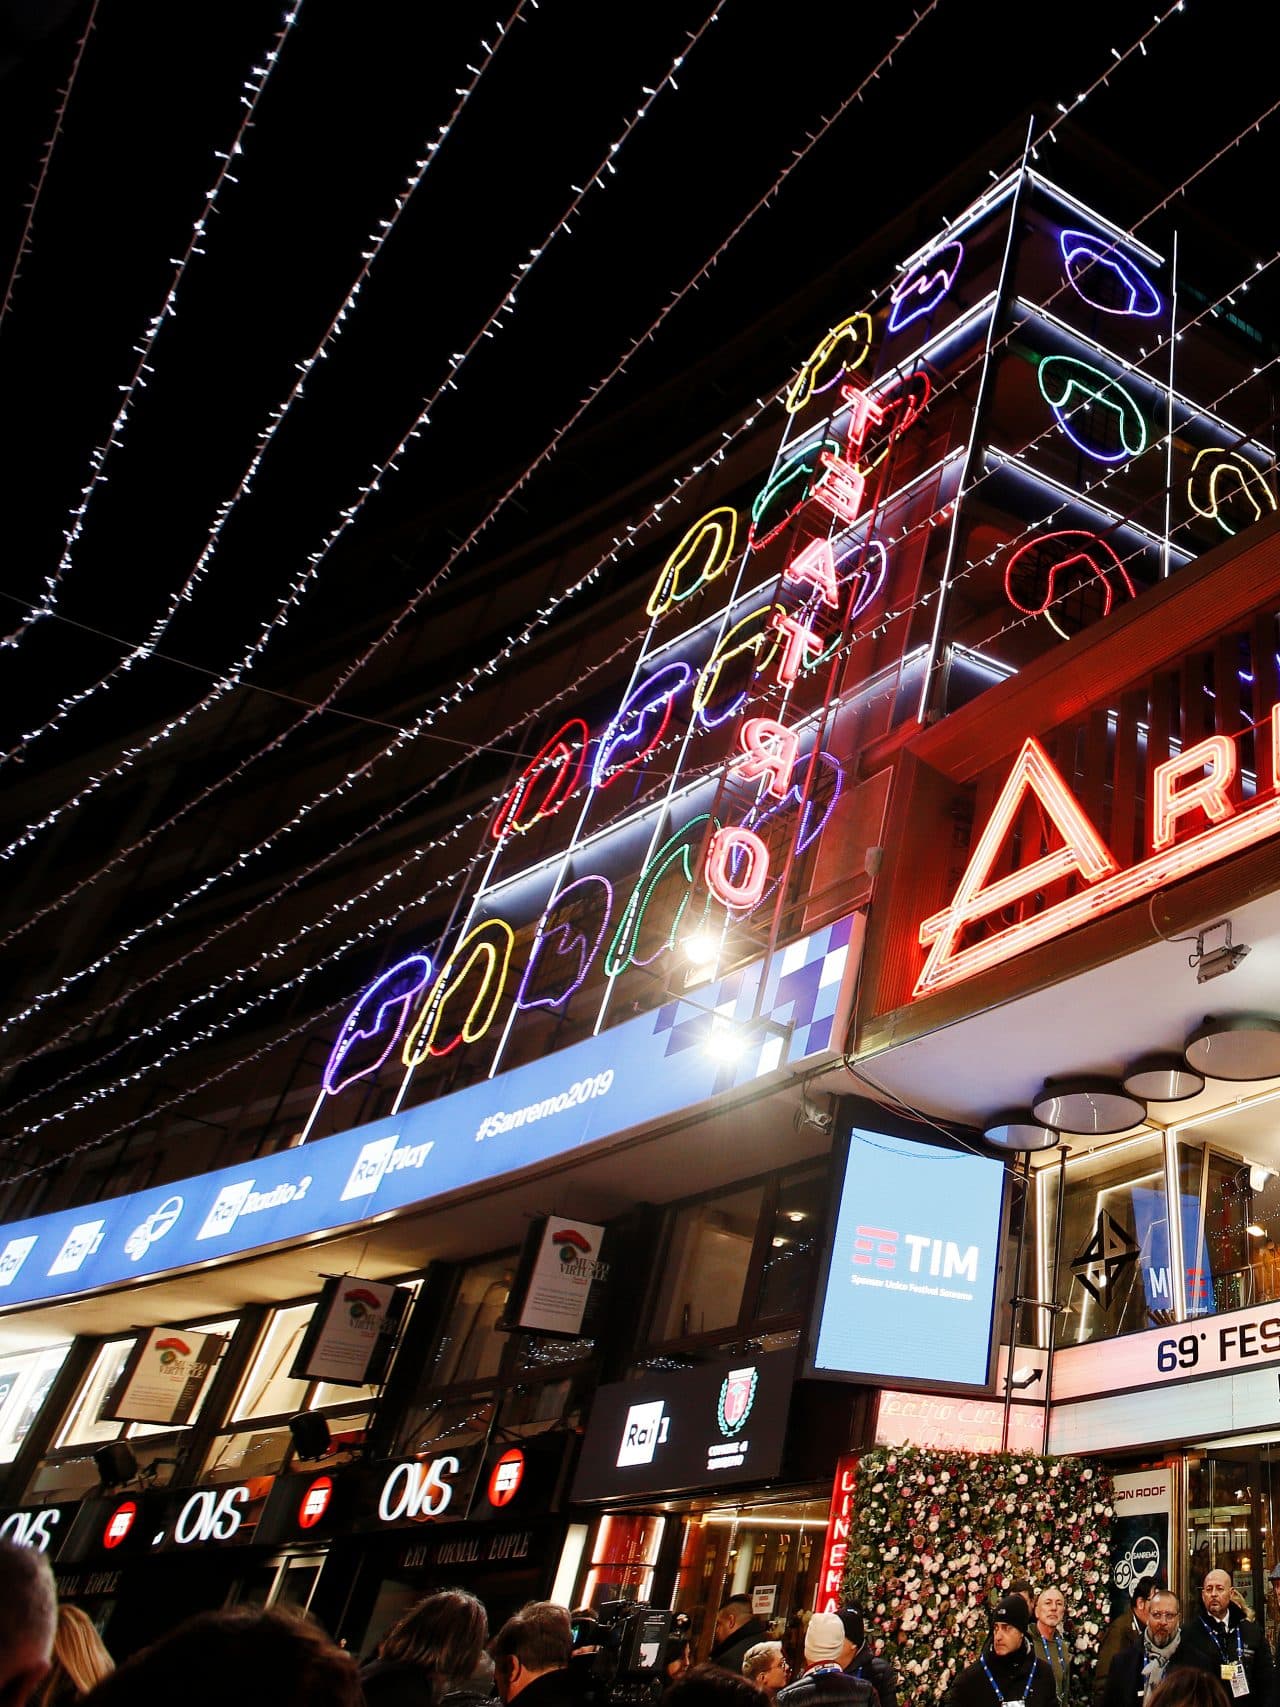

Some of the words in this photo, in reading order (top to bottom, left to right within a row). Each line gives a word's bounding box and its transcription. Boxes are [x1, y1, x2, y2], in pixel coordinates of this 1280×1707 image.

[475, 1069, 614, 1142] #Sanremo2019
[385, 1141, 434, 1175] Play
[904, 1233, 979, 1282] TIM
[656, 1416, 670, 1444] 1
[378, 1456, 459, 1521] OVS
[1136, 1486, 1166, 1498] ROOF
[175, 1486, 249, 1544] OVS
[483, 1530, 530, 1560] EOPLE
[824, 1470, 857, 1614] CINEMA
